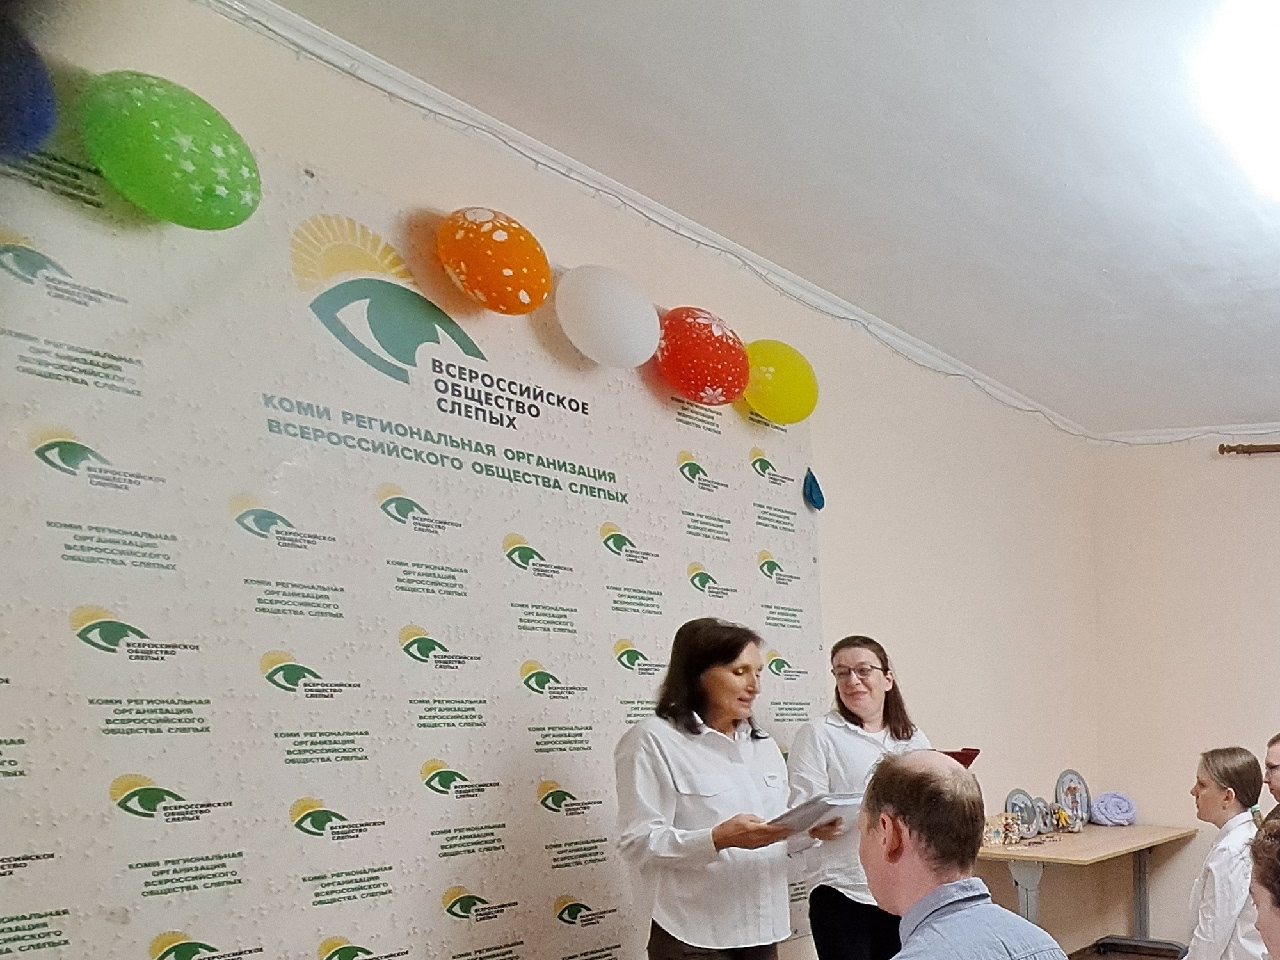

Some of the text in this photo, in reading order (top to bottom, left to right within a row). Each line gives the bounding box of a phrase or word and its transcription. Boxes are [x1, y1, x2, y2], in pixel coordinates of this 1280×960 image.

[431, 357, 589, 416] ВСЕРОССИЙСКОЕ
[434, 378, 541, 419] ОБЩЕСТВО
[436, 397, 518, 431] СЛЕПЫХ
[261, 391, 617, 484] КОМИ РЕГИОНАЛЬНАЯ ОРГАНИЗАЦИЯ
[267, 417, 629, 505] ВСЕРОССИЙСКОГО ОБЩЕСТВА СЛЕПЫХ
[128, 861, 160, 870] КОМИ
[203, 878, 242, 889] СЛЕПЫХ
